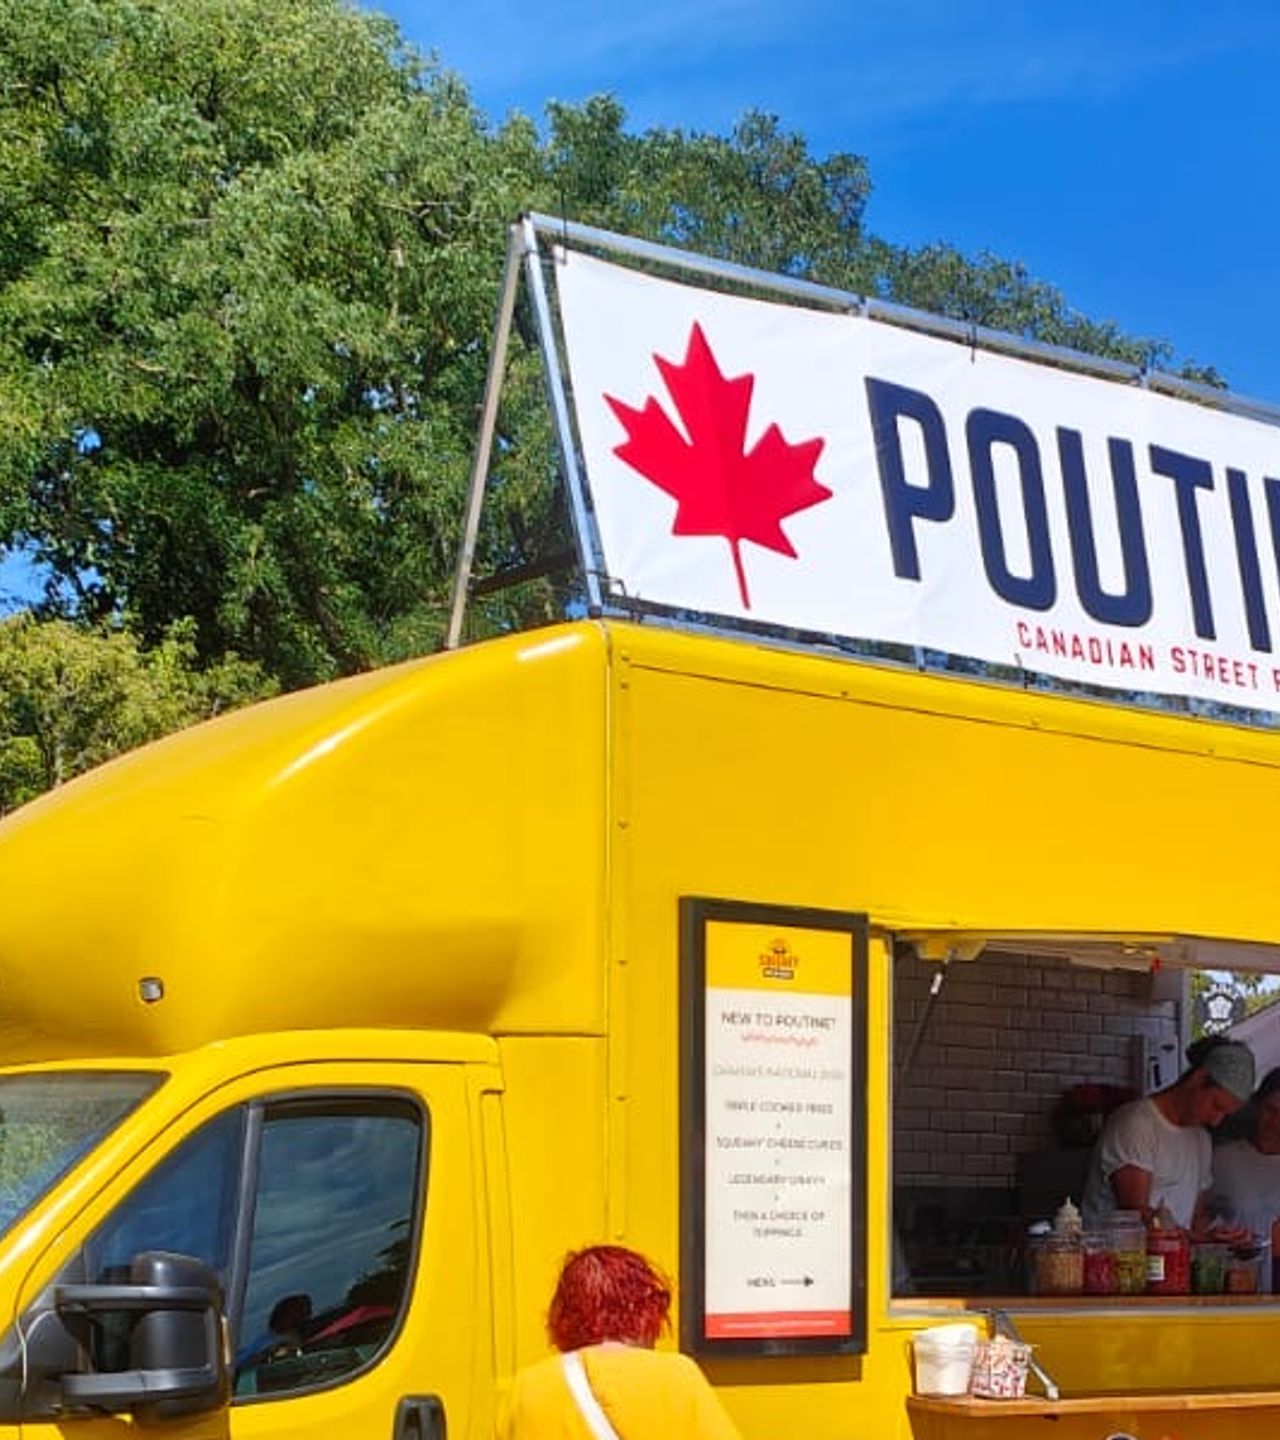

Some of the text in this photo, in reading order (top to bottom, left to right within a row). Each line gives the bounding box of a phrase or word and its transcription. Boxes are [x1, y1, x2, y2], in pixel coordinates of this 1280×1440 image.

[1016, 621, 1156, 671] CANADIAN
[1170, 647, 1259, 690] STREET
[721, 1011, 752, 1025] NEW
[756, 1013, 773, 1027] TO
